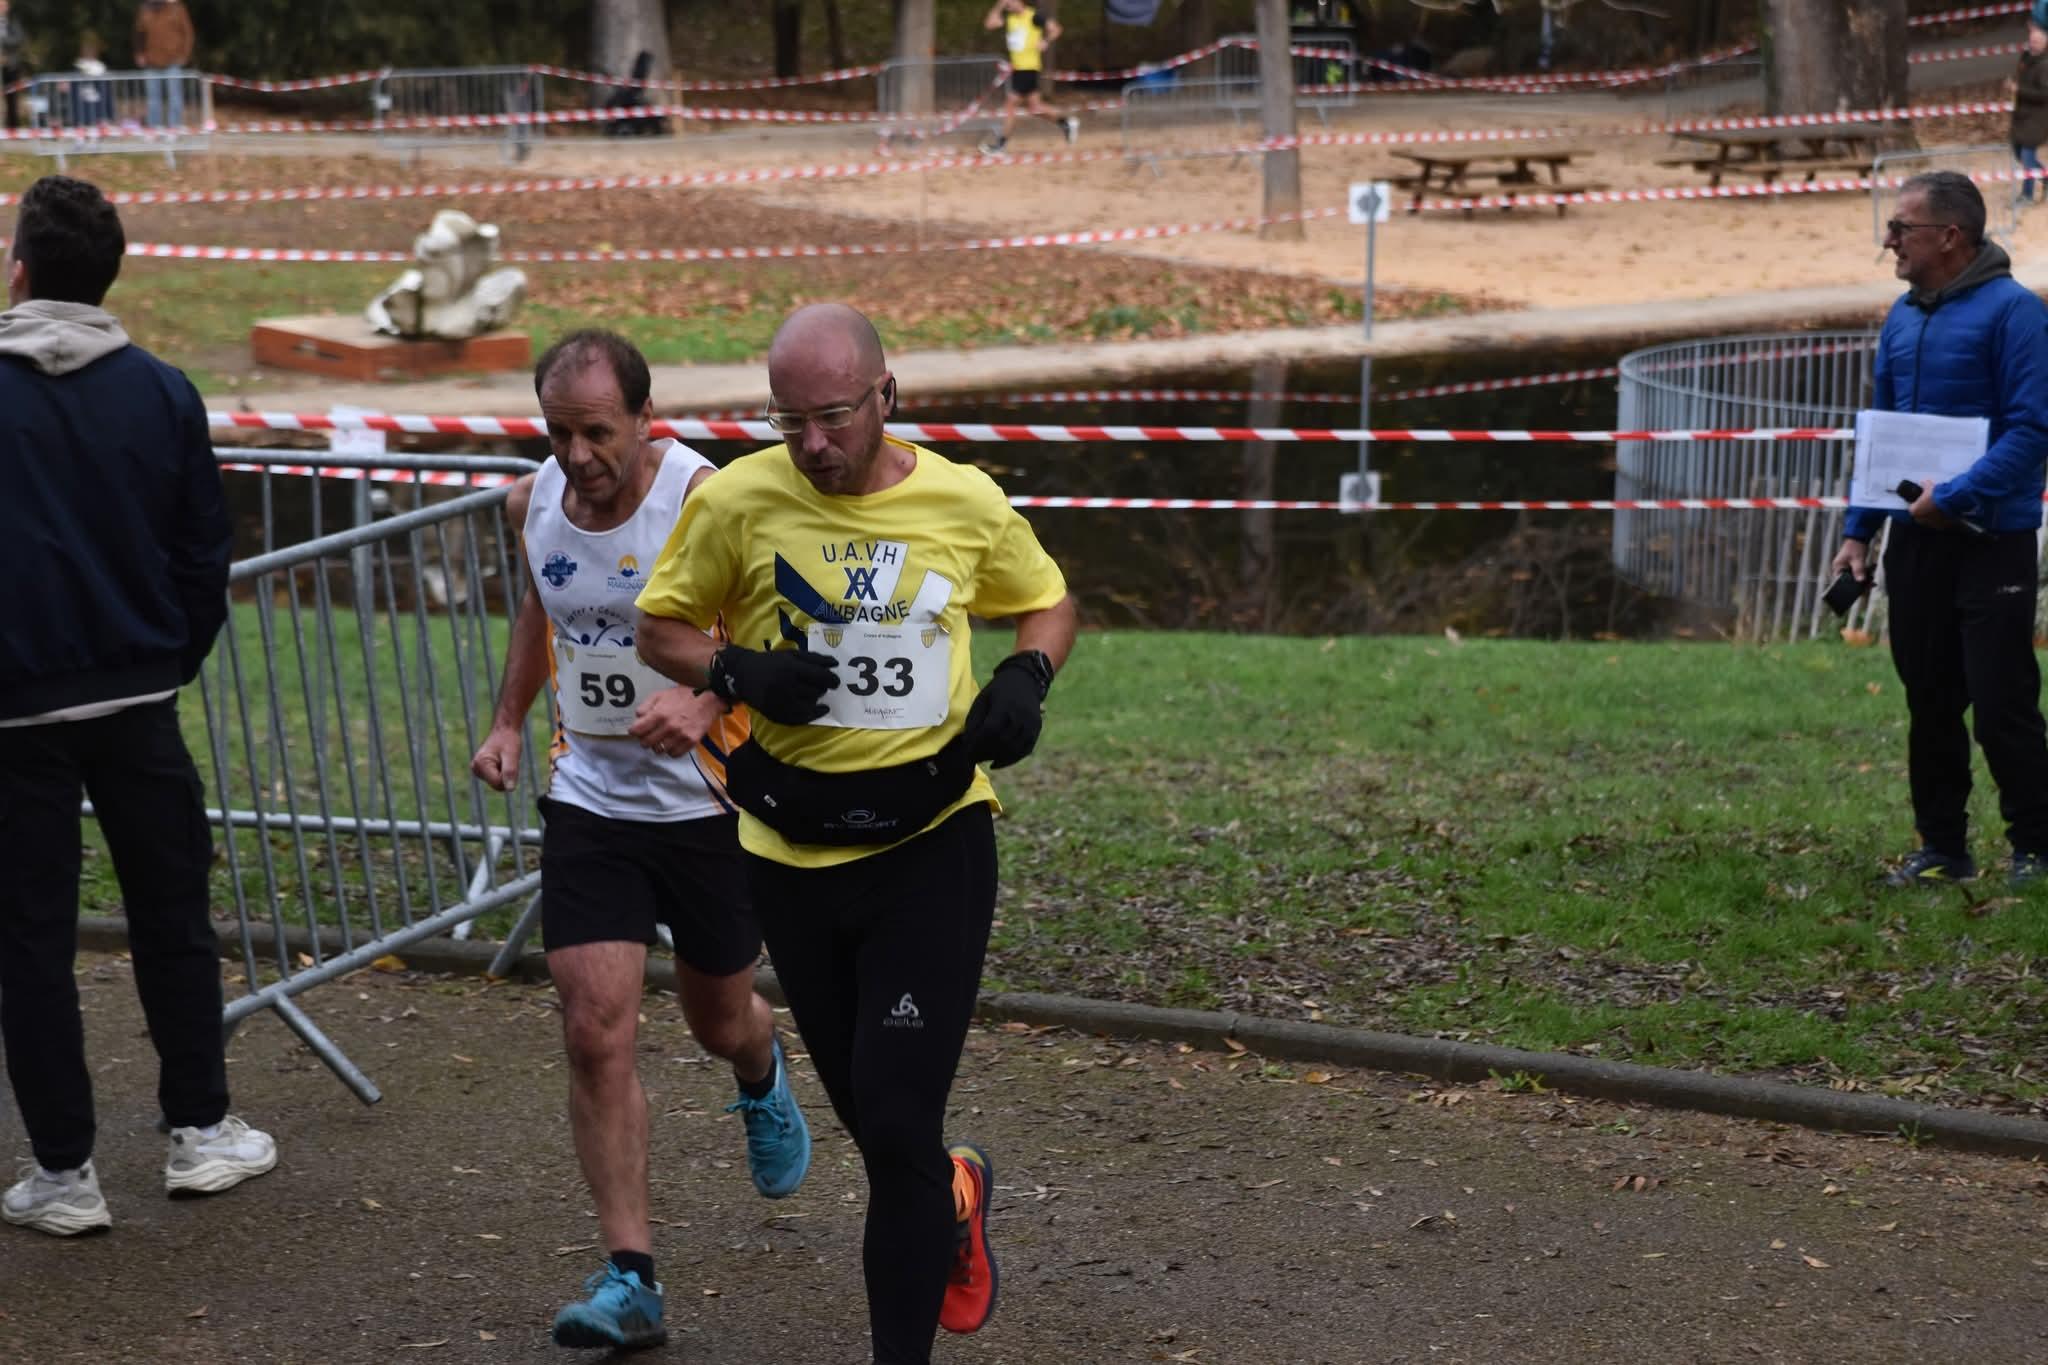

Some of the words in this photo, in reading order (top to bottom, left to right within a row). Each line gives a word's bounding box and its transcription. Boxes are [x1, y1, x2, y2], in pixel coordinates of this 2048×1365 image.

[822, 541, 898, 566] U.A.V.H
[814, 599, 911, 624] AUBAGNE
[580, 672, 635, 708] 59
[846, 656, 914, 698] 33
